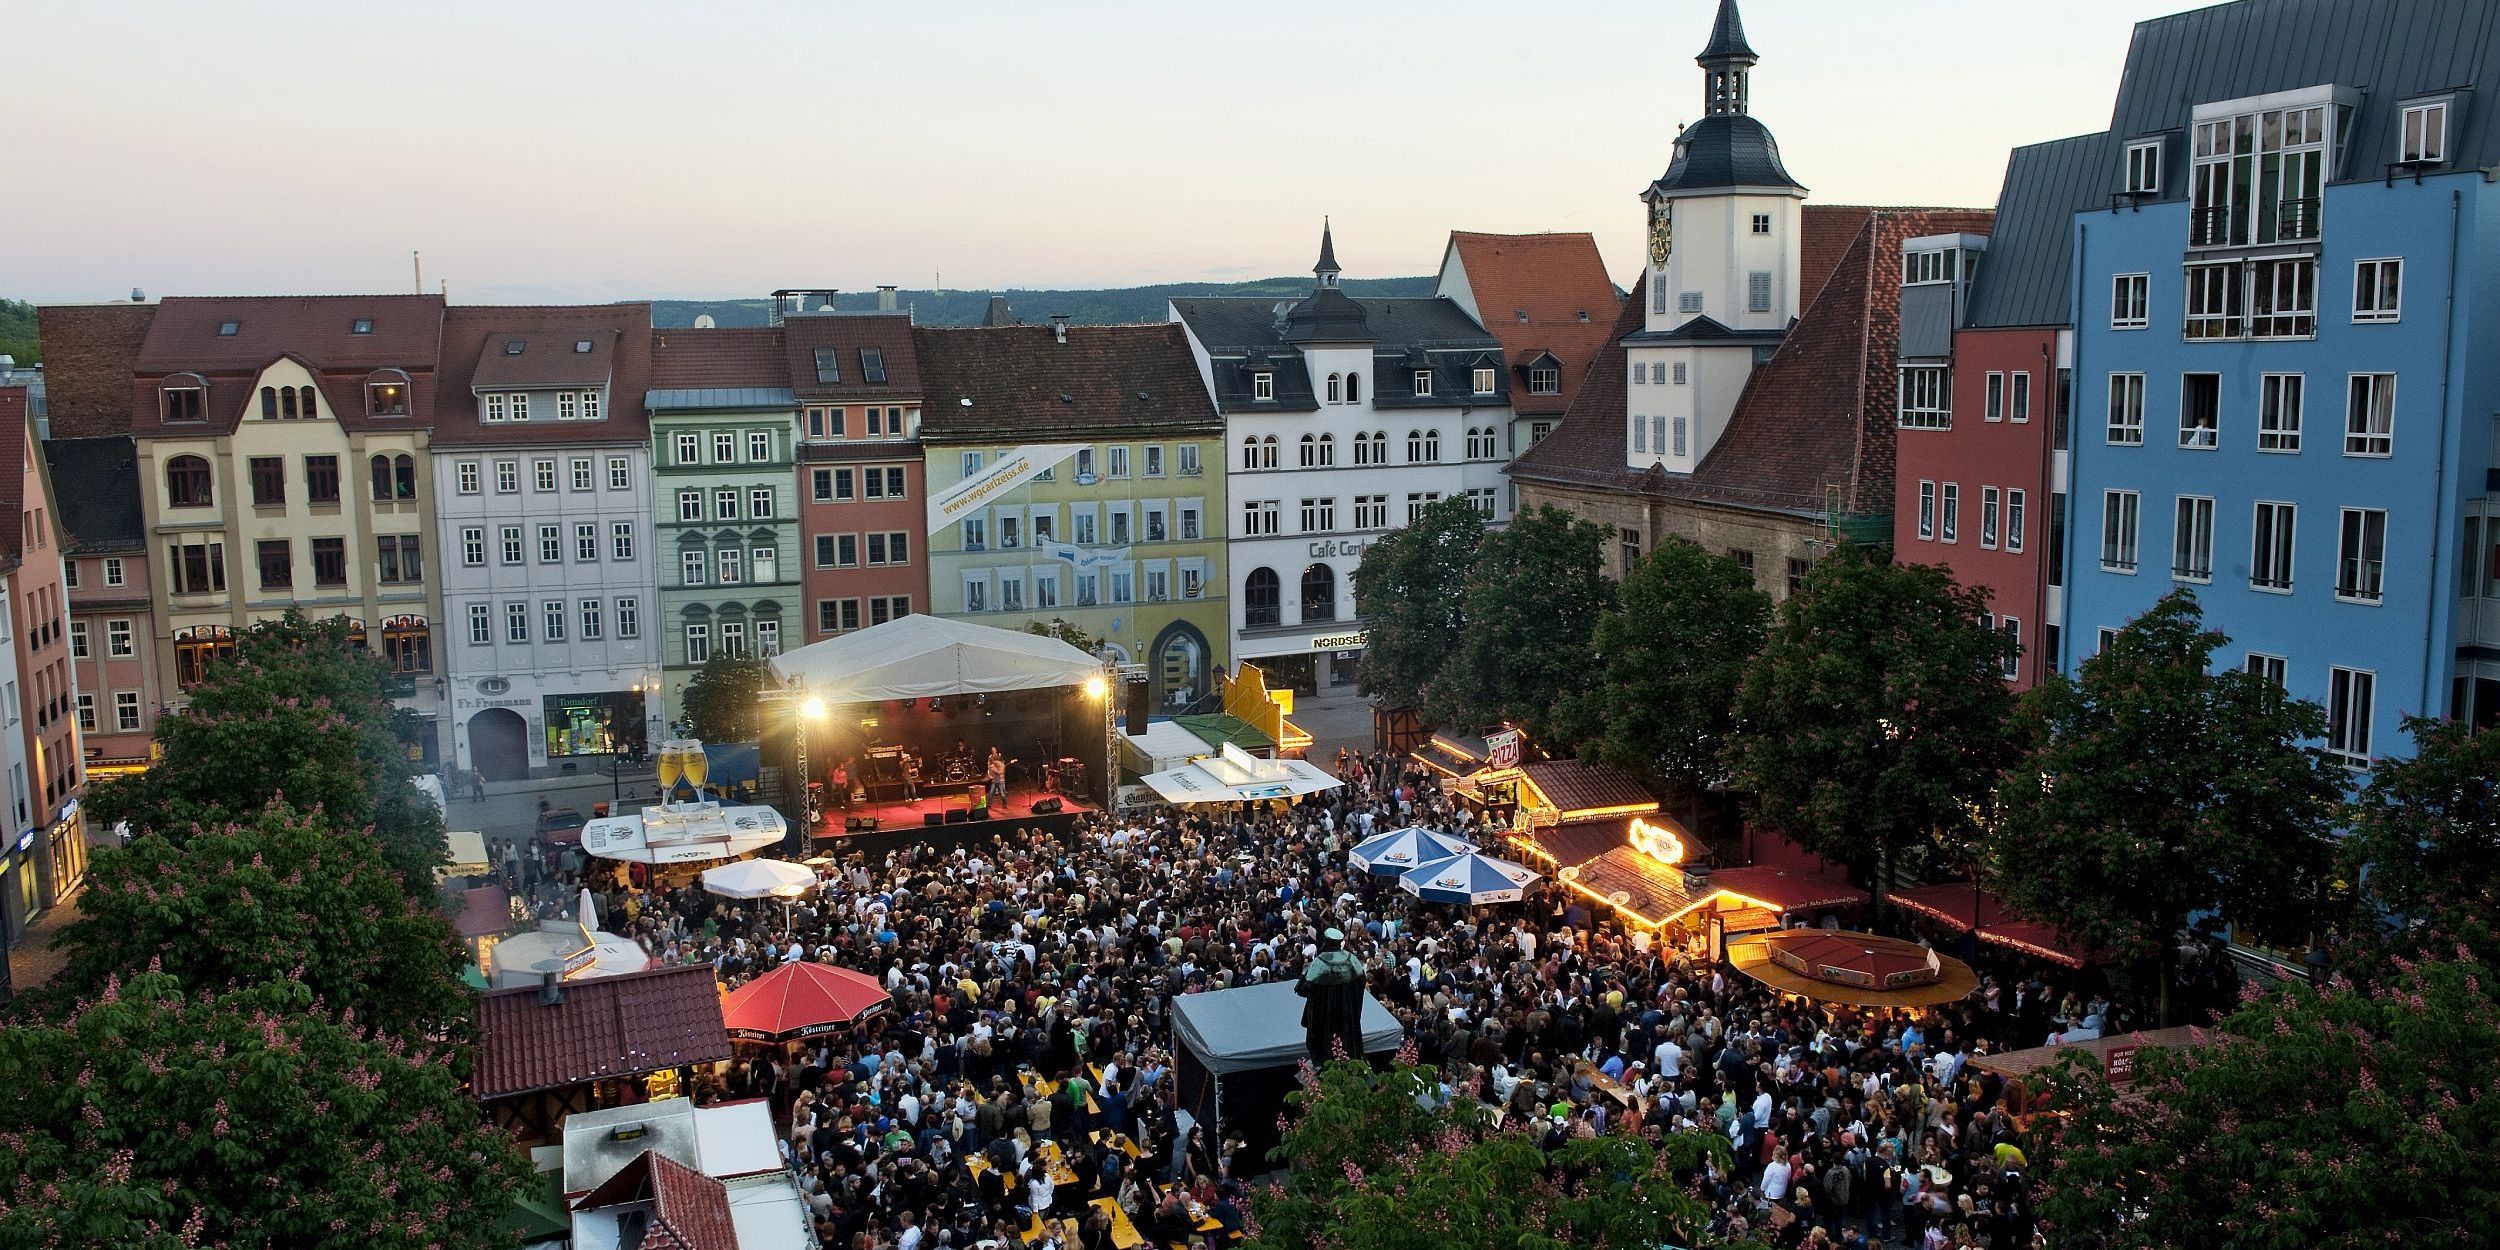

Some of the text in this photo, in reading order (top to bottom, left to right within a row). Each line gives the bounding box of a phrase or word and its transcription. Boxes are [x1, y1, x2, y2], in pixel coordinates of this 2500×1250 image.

[943, 461, 1030, 515] www.wgcarlzeiss.de
[1309, 538, 1365, 558] Café Cent
[1491, 743, 1518, 765] PIZZA
[801, 1023, 836, 1037] Köstritzer
